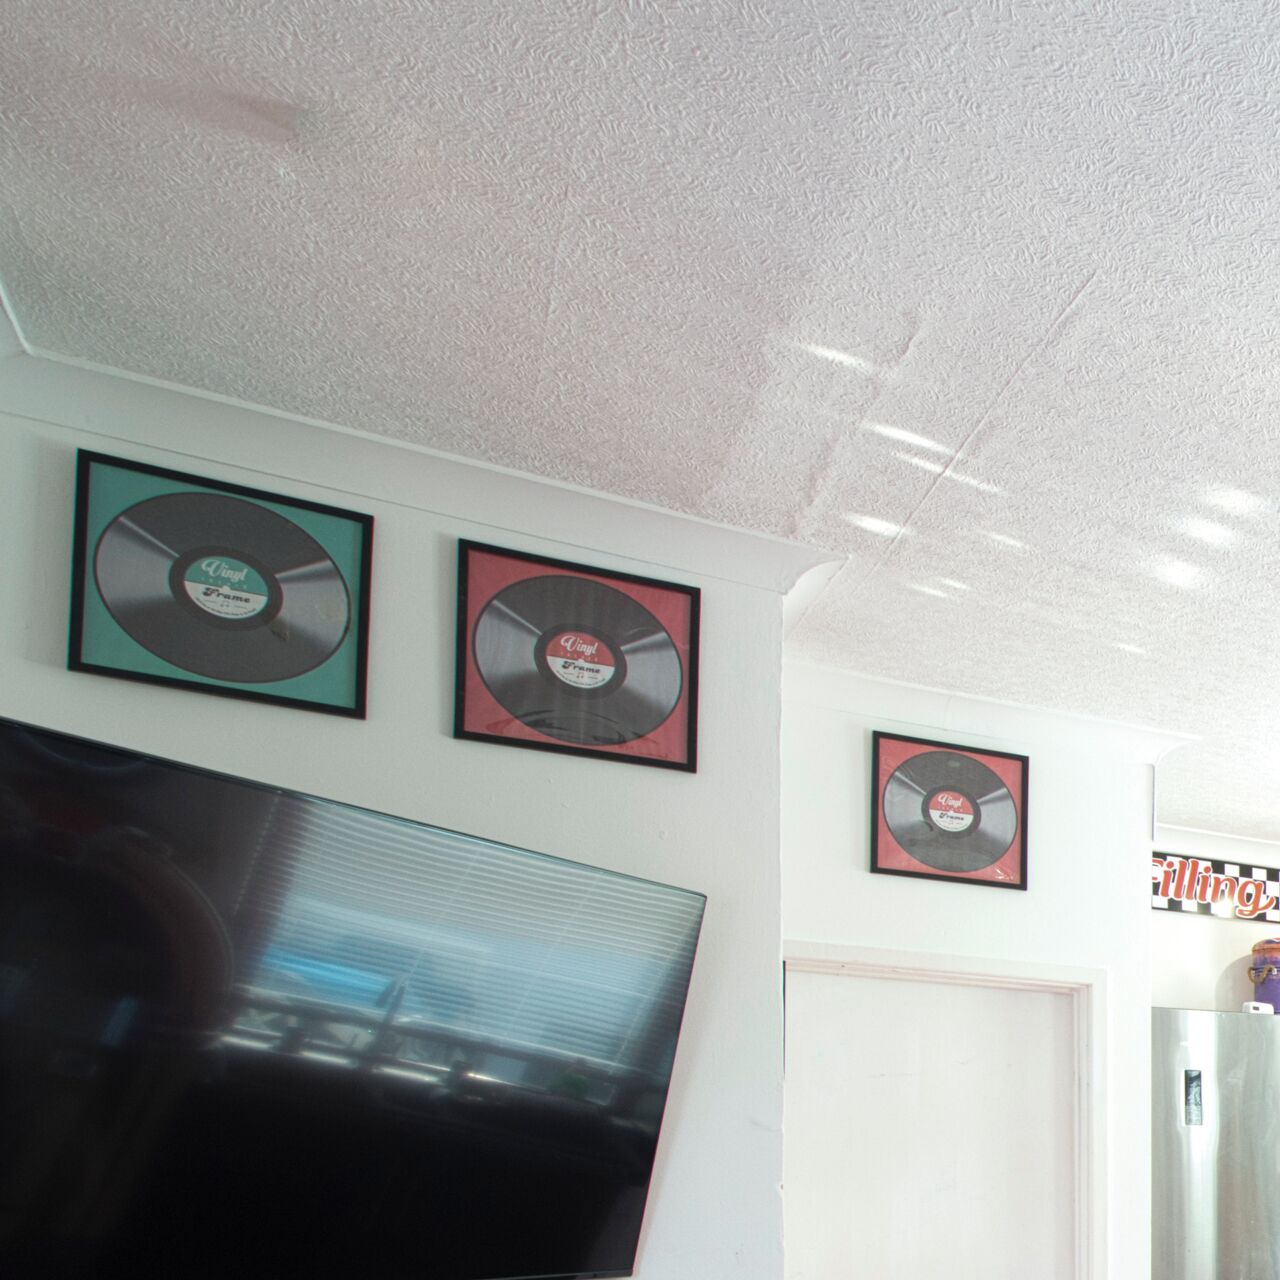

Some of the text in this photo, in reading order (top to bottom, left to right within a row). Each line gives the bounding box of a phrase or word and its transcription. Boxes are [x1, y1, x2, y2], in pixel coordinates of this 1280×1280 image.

[201, 559, 248, 583] Vinyl
[202, 587, 251, 603] Frame
[560, 635, 598, 656] Vinyl
[561, 661, 600, 673] Frame
